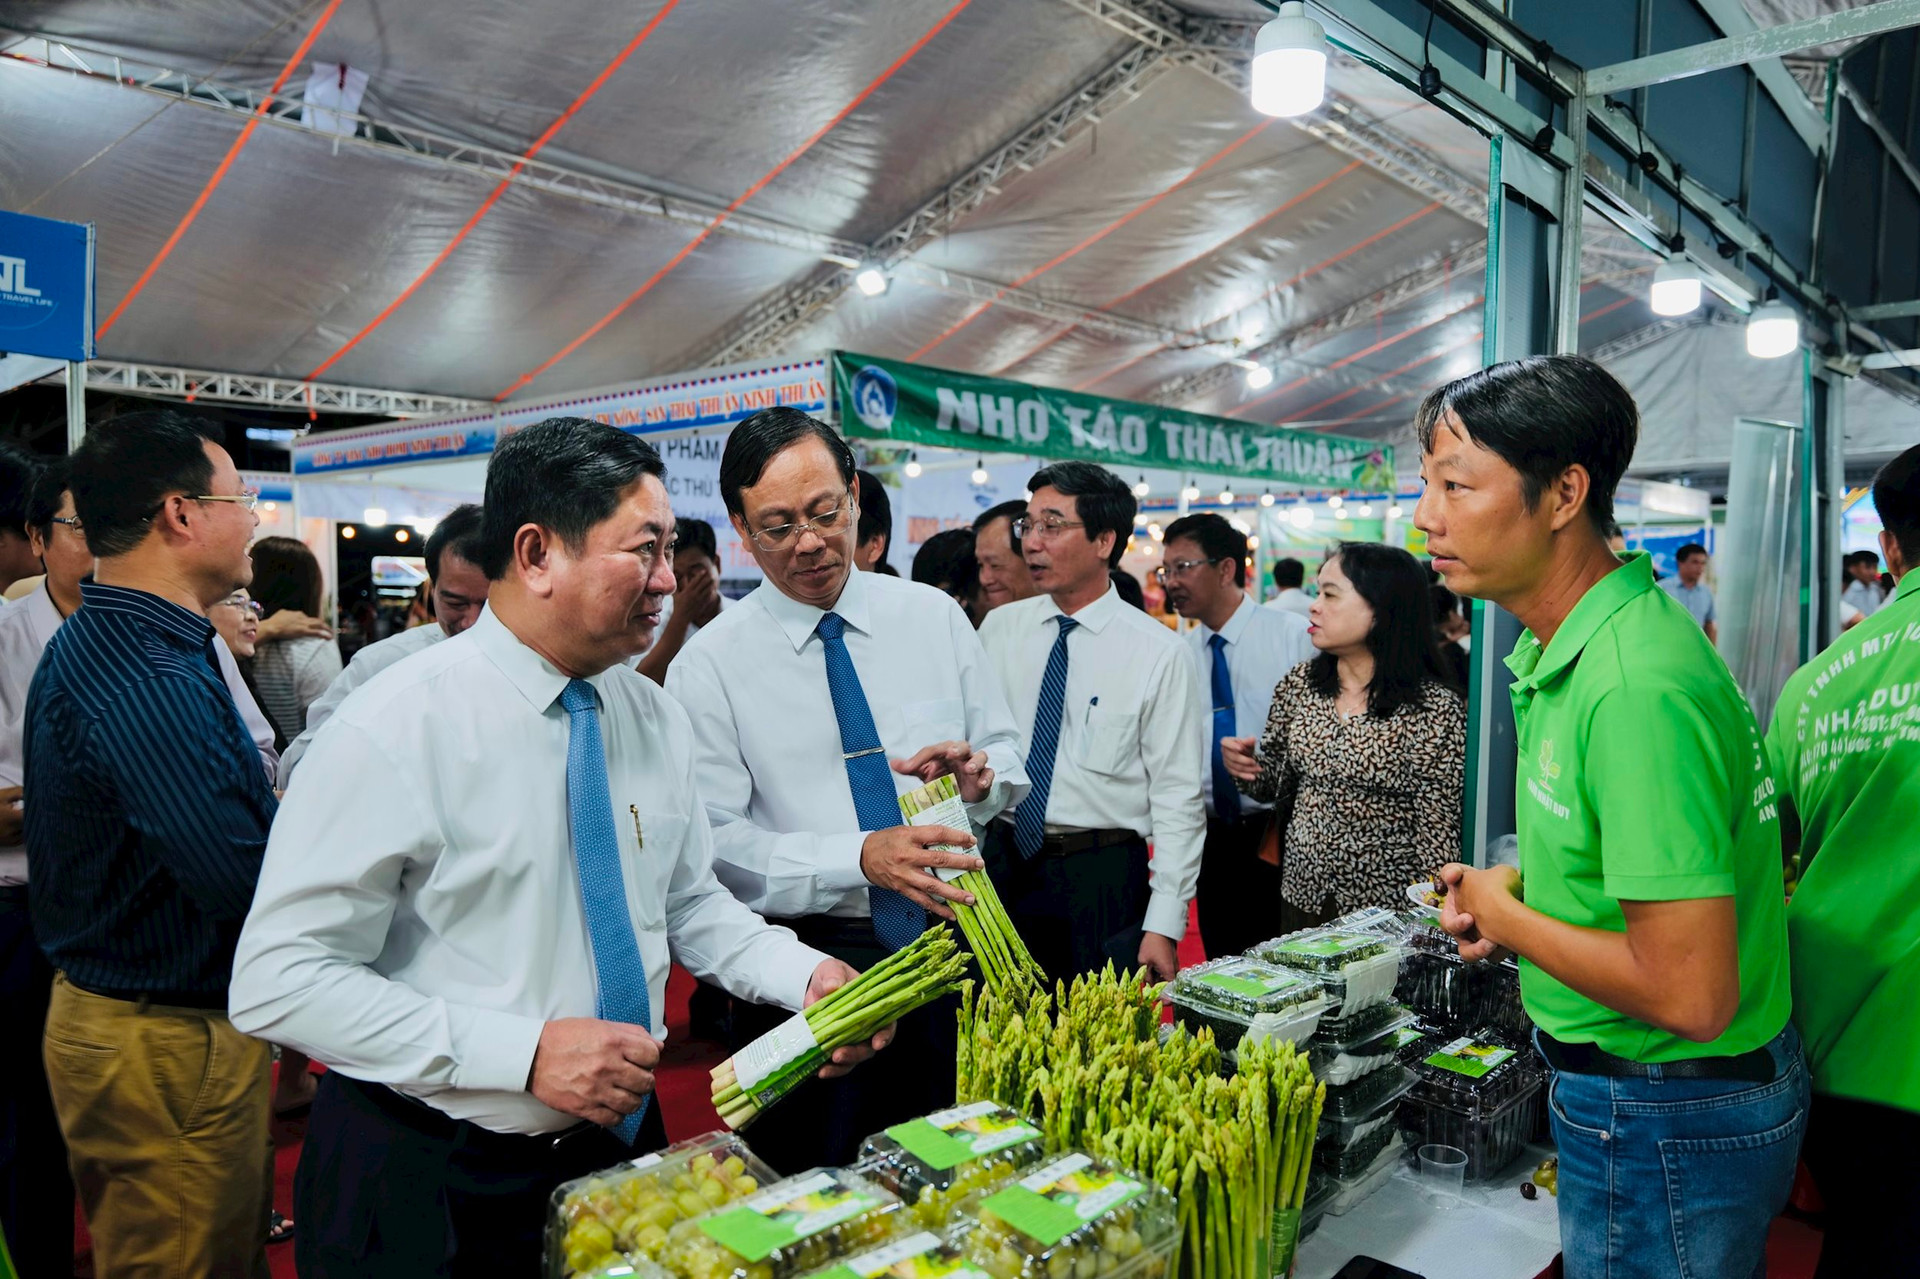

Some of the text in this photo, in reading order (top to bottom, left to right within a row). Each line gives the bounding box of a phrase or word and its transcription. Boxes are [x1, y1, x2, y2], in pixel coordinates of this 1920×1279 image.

[3, 293, 34, 305] TRAVEL
[36, 299, 53, 307] LIFE
[743, 387, 776, 410] NINH
[936, 387, 1050, 443] NHO
[1063, 404, 1149, 456] TÁO
[1160, 421, 1246, 469] THÁI
[1807, 649, 1856, 698] TNHH
